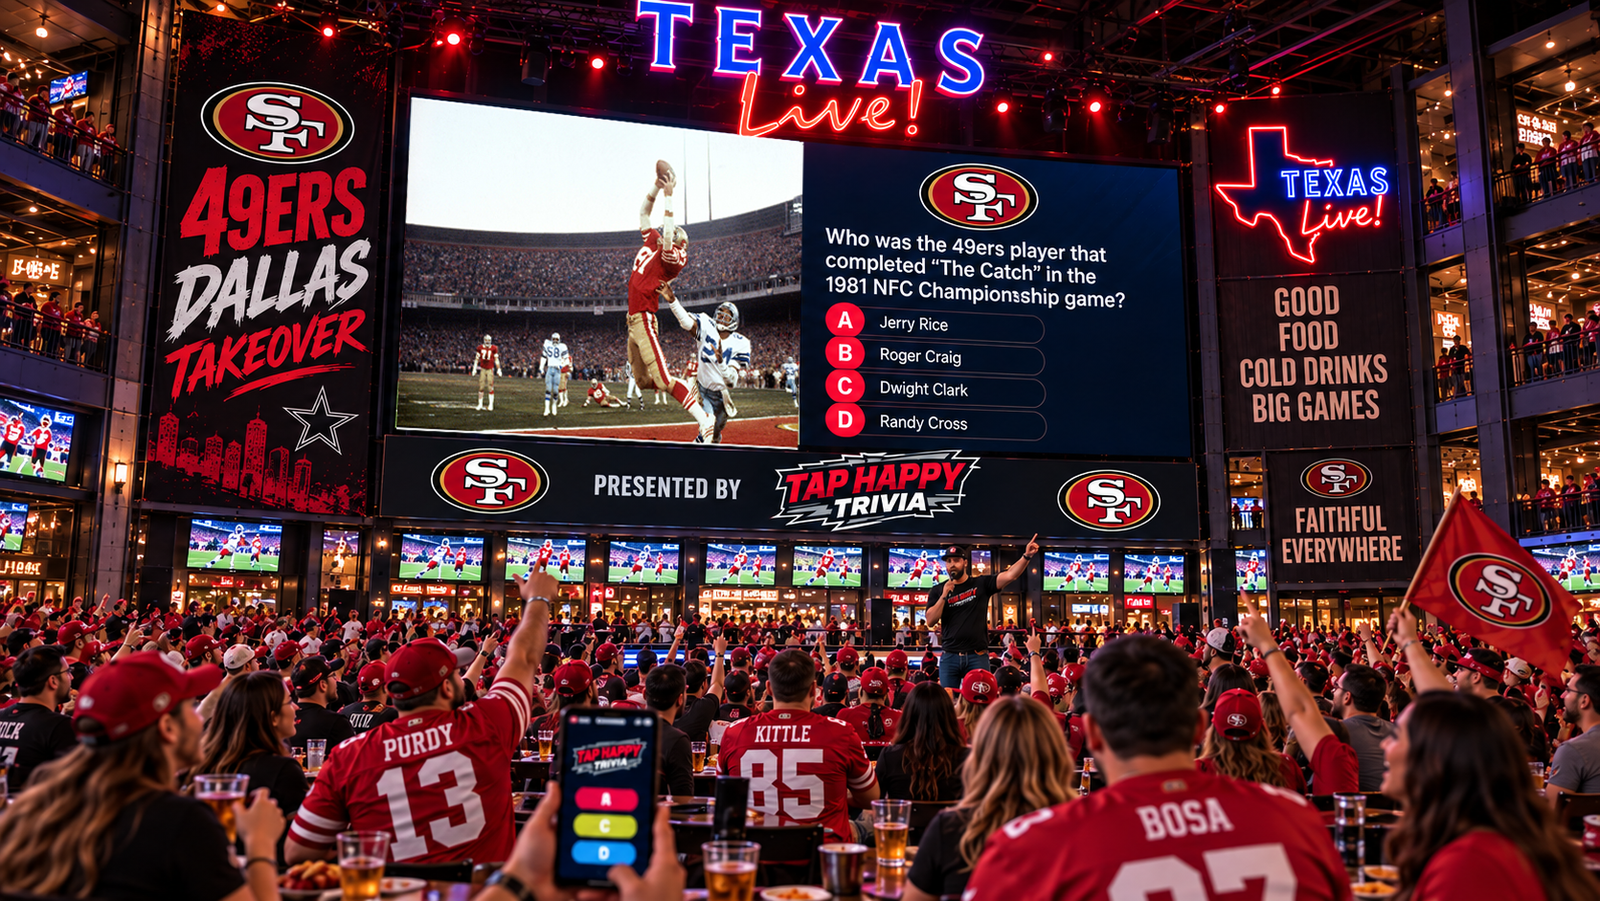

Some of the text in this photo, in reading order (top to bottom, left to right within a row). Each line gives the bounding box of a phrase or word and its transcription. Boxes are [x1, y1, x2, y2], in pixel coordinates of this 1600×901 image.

[635, 0, 985, 98] TEXAS
[738, 70, 924, 138] Live!
[1280, 166, 1389, 199] TEXAS
[180, 164, 368, 258] 49ERS
[1301, 195, 1384, 235] Live!
[825, 227, 1107, 263] Who was the 49ers player that
[825, 254, 926, 275] completed
[1046, 265, 1063, 283] in
[1066, 267, 1097, 284] the
[165, 238, 371, 343] DALLAS
[825, 276, 867, 294] 1981
[873, 278, 913, 297] NFC
[1064, 291, 1126, 310] game?
[1274, 286, 1340, 317] GOOD
[837, 311, 949, 332] A Jerry Rice
[1278, 320, 1339, 352] FOOD
[164, 309, 370, 403] TAKEOVER
[838, 344, 962, 367] B Roger Craig
[1240, 354, 1388, 388] COLD DRINKS
[836, 377, 968, 398] C Dwight Clark
[838, 410, 968, 432] D Randy Cross
[1252, 389, 1380, 423] BIG GAMES
[594, 474, 742, 500] PRESENTED BY
[785, 461, 967, 503] TAP HAPPY
[834, 492, 927, 519] TRIVIA
[1295, 505, 1387, 533] FAITHFUL
[1282, 535, 1403, 564] EVERYWHERE
[383, 723, 453, 761] PURDY
[754, 725, 812, 743] KITTLE
[577, 744, 642, 764] TAP HAPPY
[594, 757, 628, 771] TRIVIA
[600, 792, 611, 807] A
[740, 748, 825, 820] 85
[376, 750, 486, 861] 13
[1136, 797, 1234, 841] BOSA
[598, 817, 611, 834] C
[598, 845, 610, 861] D
